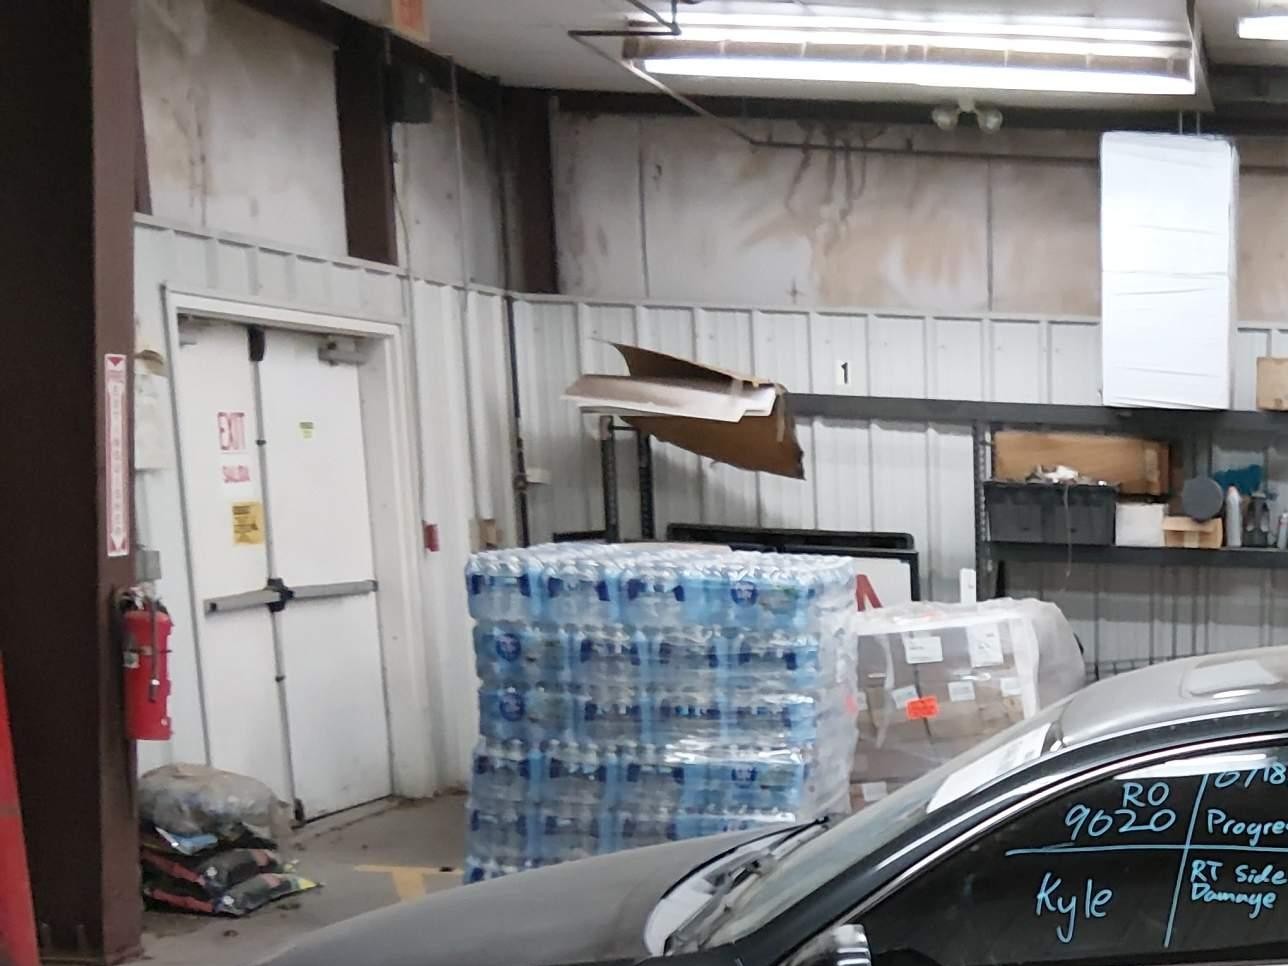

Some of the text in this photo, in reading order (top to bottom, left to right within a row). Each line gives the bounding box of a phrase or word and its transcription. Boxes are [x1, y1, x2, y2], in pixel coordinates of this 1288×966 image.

[840, 361, 849, 385] 1
[1122, 781, 1170, 808] RO
[1190, 859, 1288, 885] RT Side
[1036, 872, 1113, 943] Kyle
